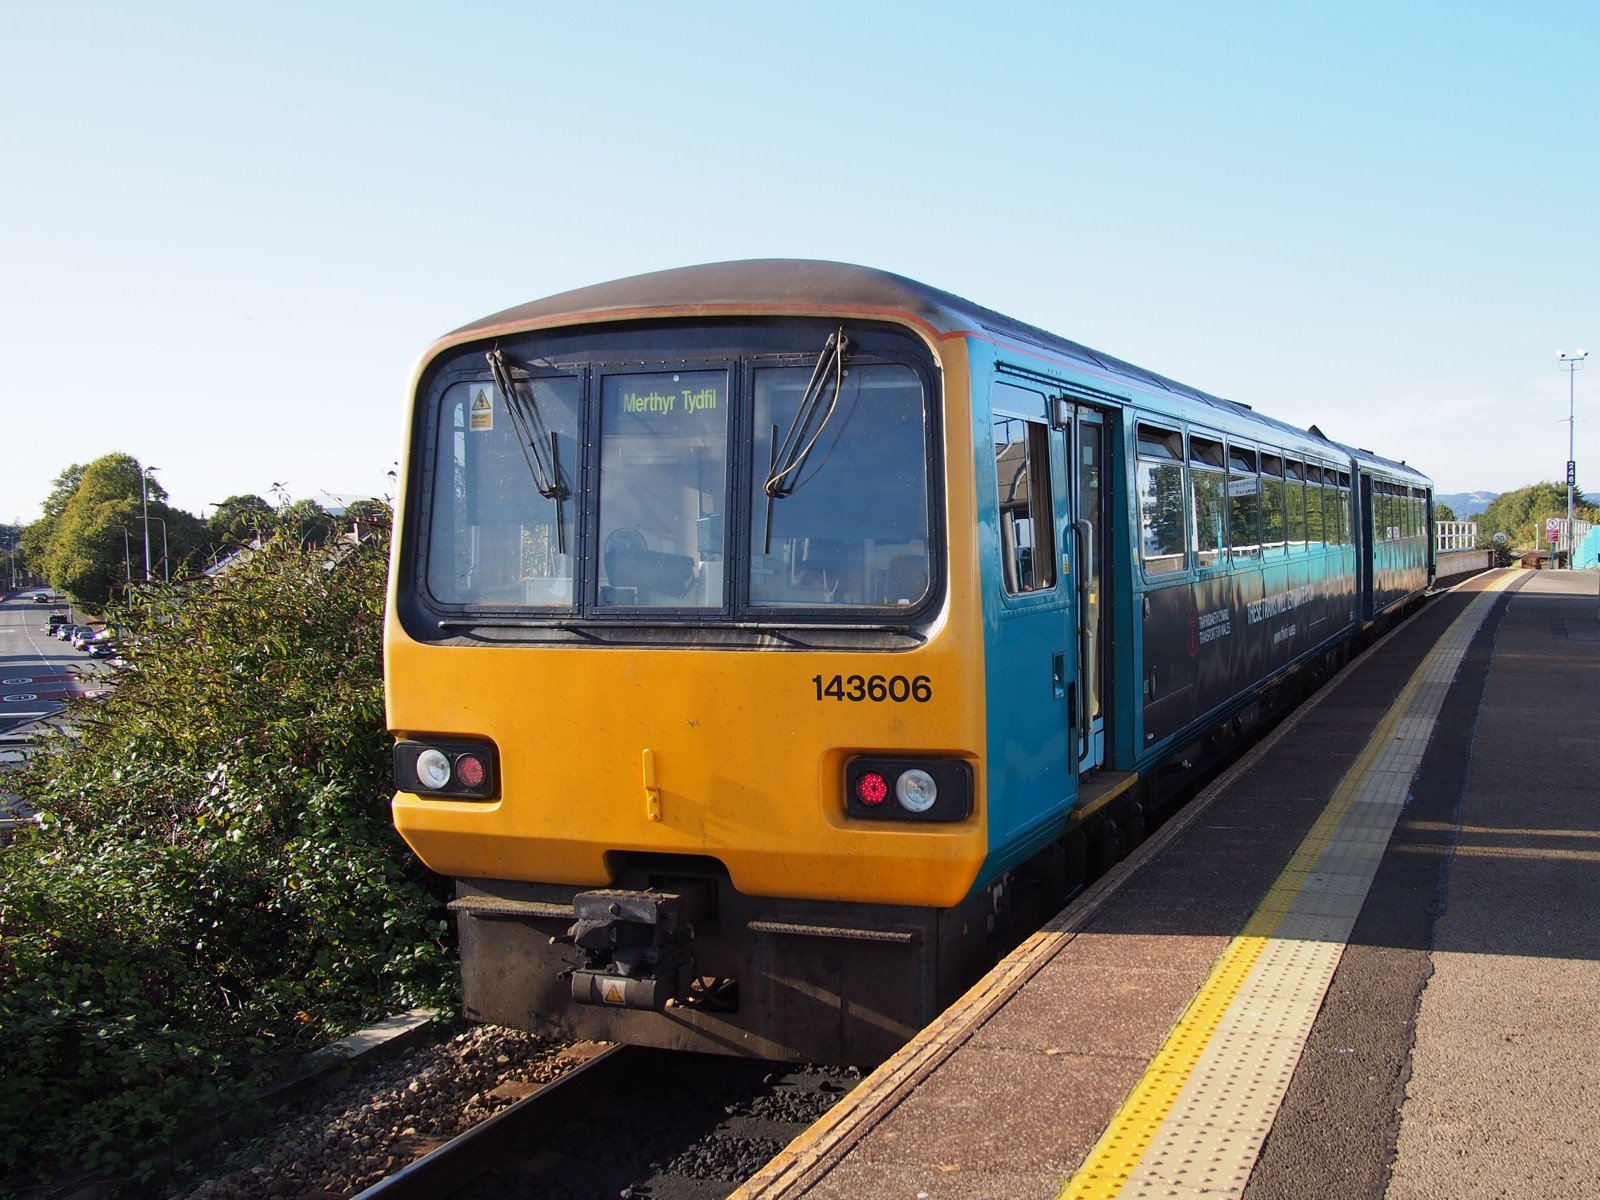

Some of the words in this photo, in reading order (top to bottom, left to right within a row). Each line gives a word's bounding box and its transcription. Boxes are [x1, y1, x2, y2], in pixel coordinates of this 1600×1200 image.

[623, 391, 676, 415] Merthyr
[681, 388, 717, 414] Tydfil
[812, 674, 932, 702] 143606
